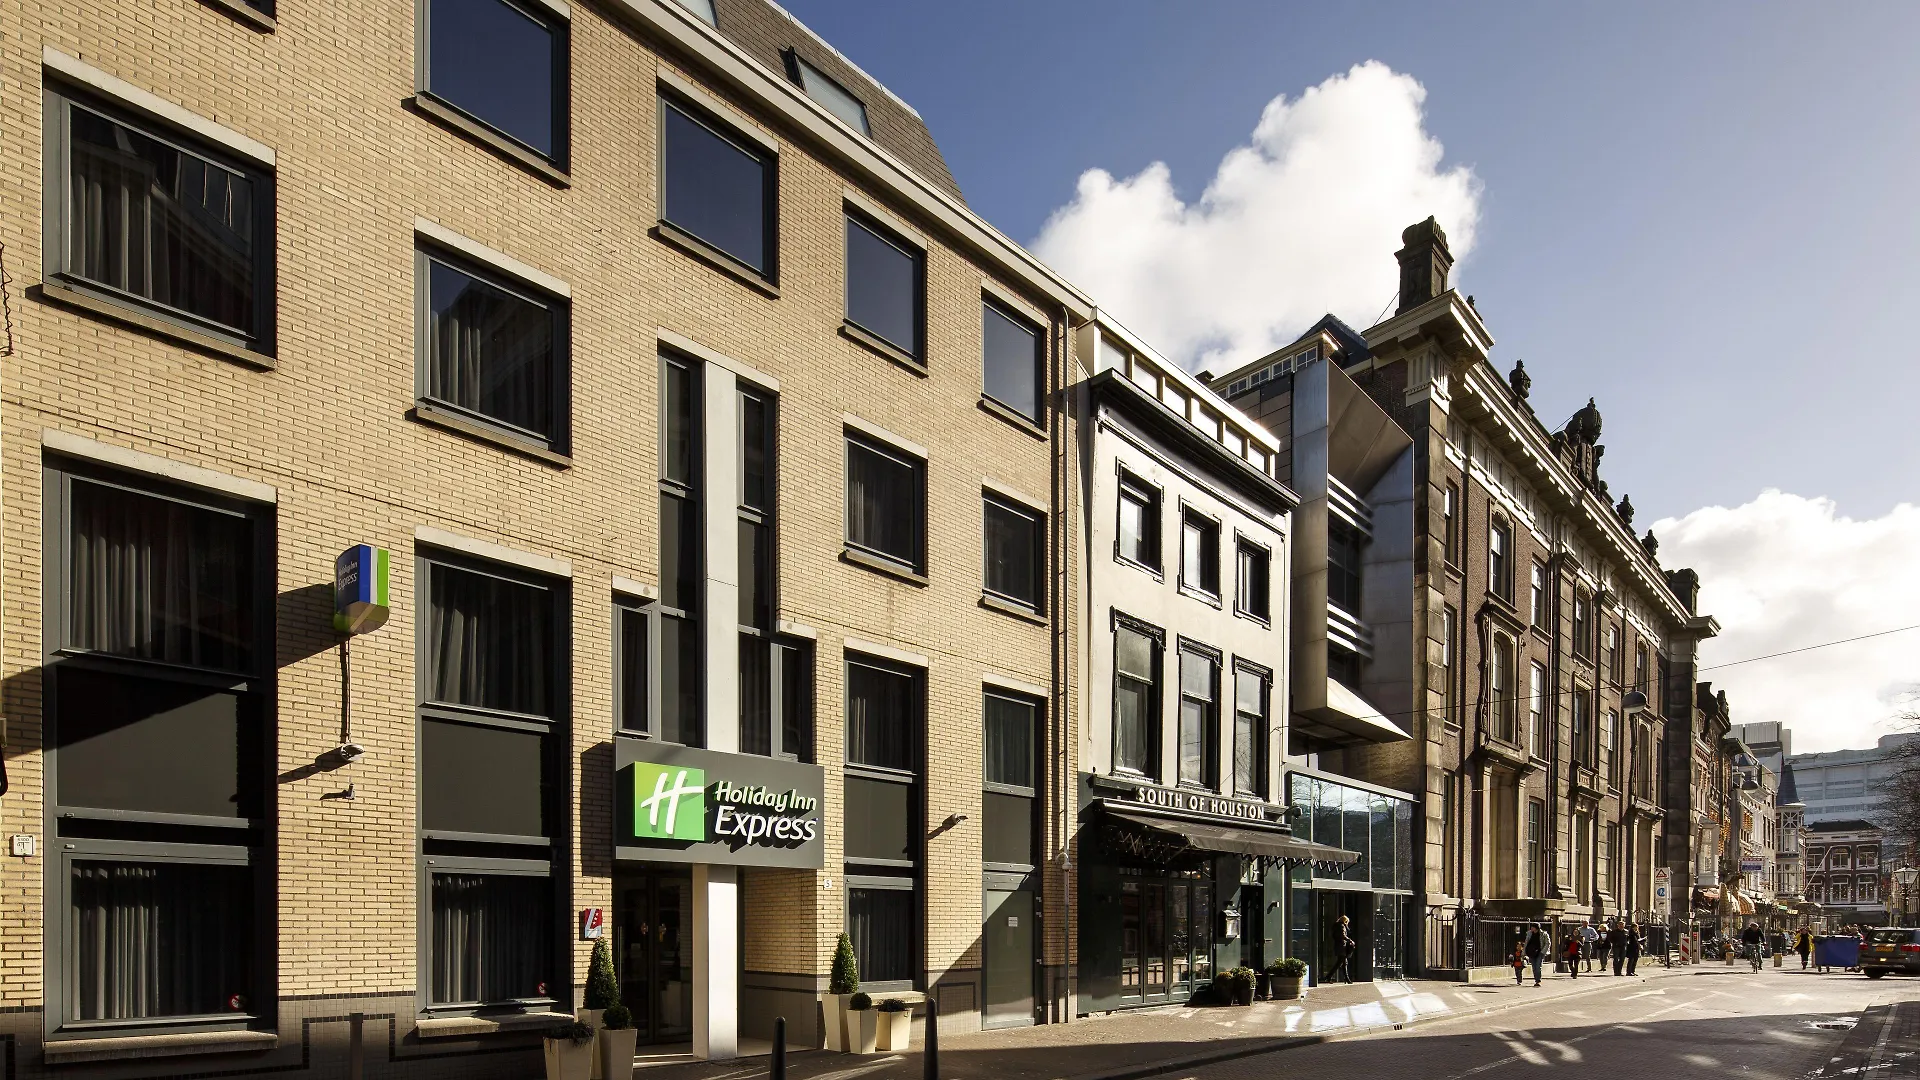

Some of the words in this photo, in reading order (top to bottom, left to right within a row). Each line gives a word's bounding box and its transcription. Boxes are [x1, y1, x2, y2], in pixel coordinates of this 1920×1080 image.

[715, 780, 788, 812] Holiday
[789, 788, 817, 811] Inn
[1138, 787, 1183, 808] SOUTH
[1189, 795, 1205, 811] OF
[1211, 799, 1265, 820] HOUSTON
[715, 805, 817, 844] Express
